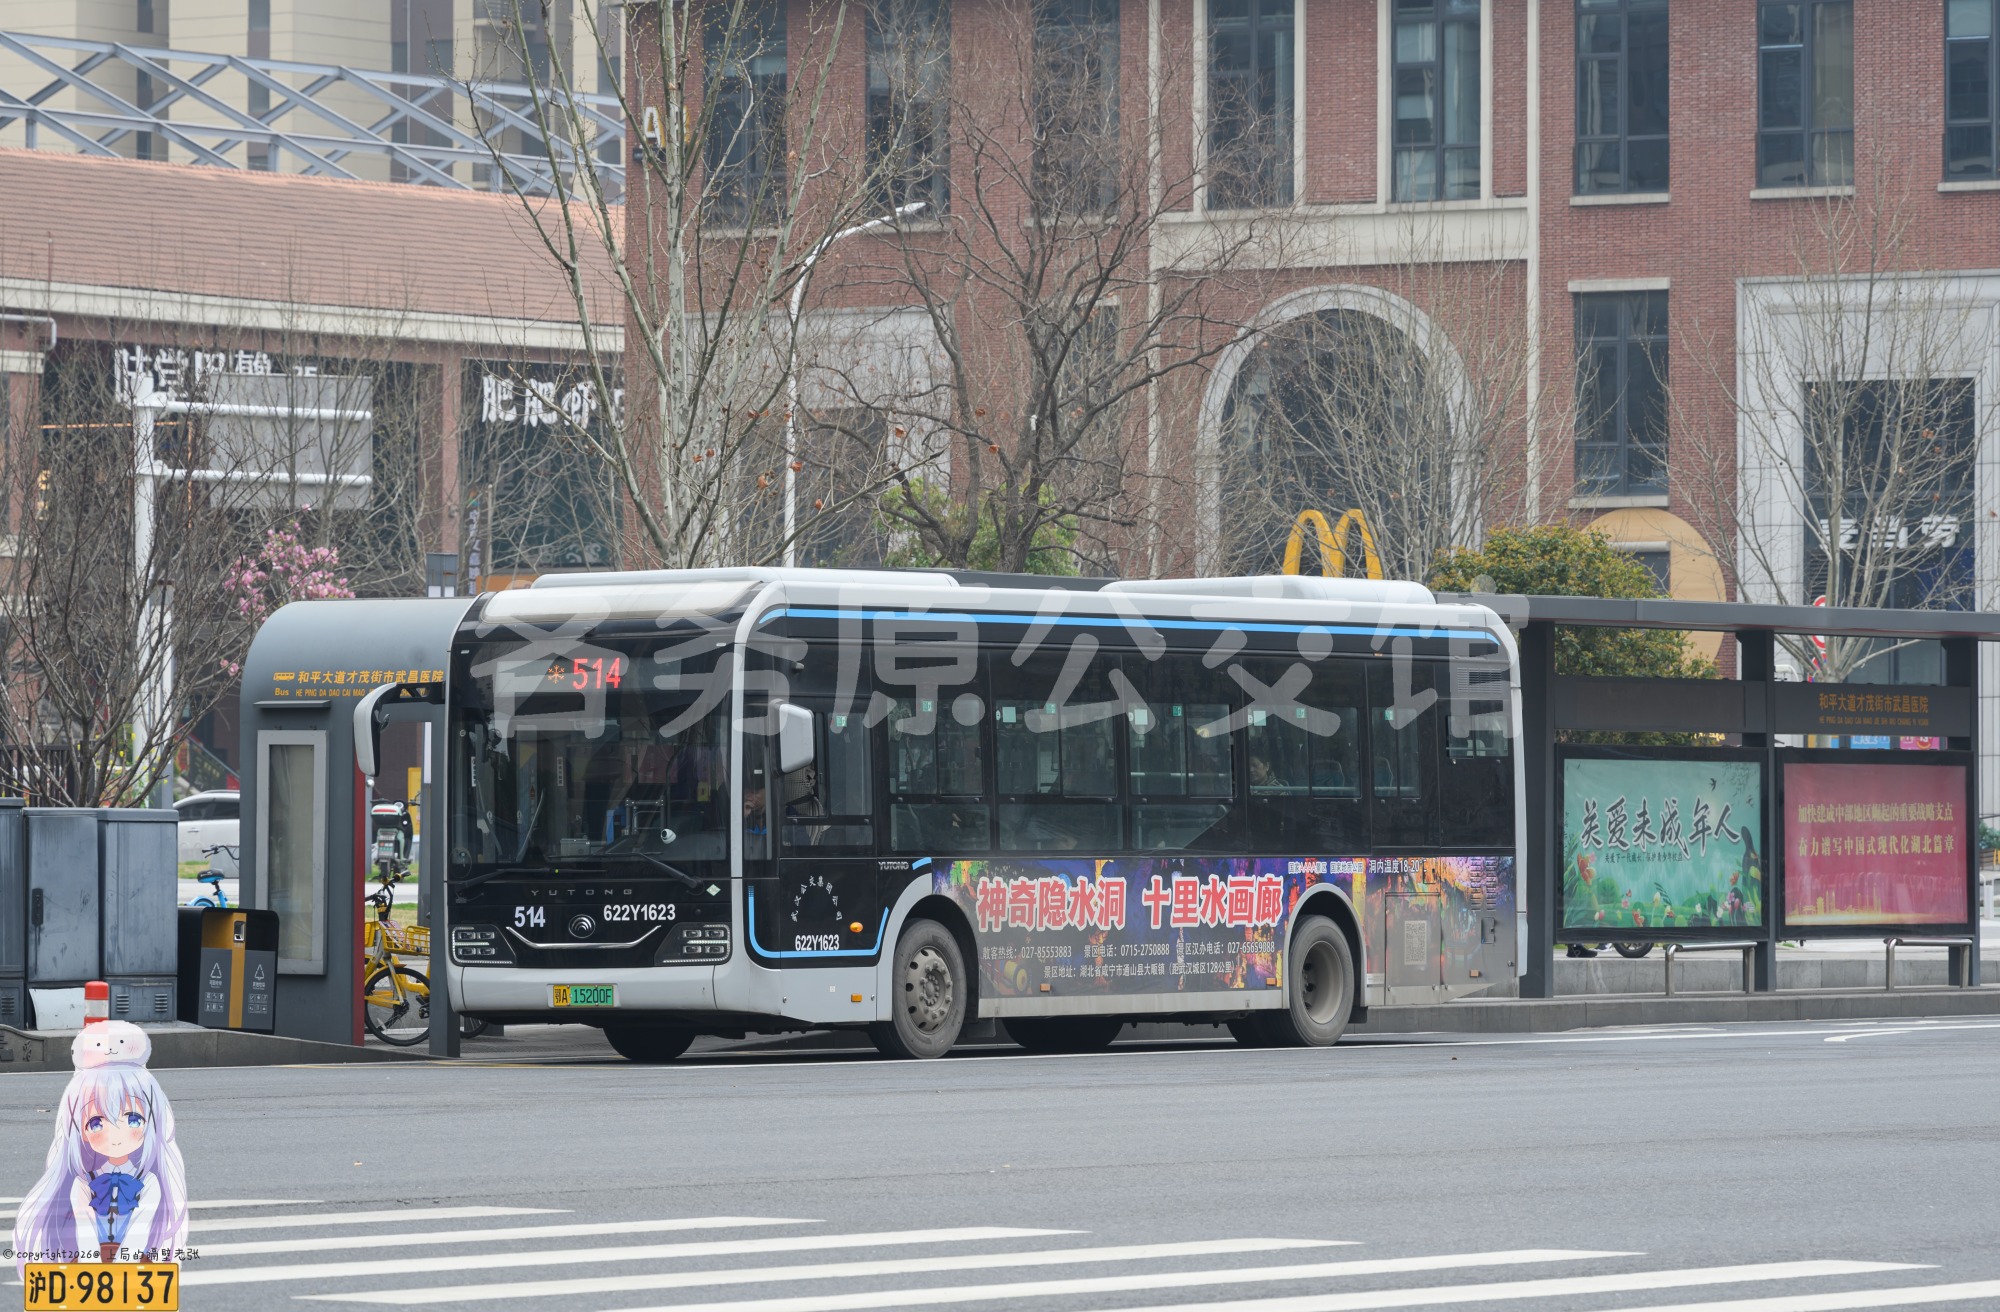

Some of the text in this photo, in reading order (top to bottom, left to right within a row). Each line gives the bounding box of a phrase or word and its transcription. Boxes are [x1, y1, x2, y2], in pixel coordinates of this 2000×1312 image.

[298, 670, 444, 684] 和平大道才茂街市武昌医院
[573, 657, 621, 690] 514
[274, 687, 290, 696] Bus
[1819, 693, 1929, 713] 和平大道才茂街市武昌医院
[1580, 795, 1742, 858] 关爱未成年人
[1799, 834, 1955, 856] 奋力谱写中国式现代化湖北篇章
[879, 861, 909, 870] YUTONG
[603, 904, 676, 921] 622Y1623
[977, 873, 1284, 932] 神奇隐水洞 十里水画廊
[514, 906, 546, 928] 514
[795, 935, 840, 951] 622Y1623
